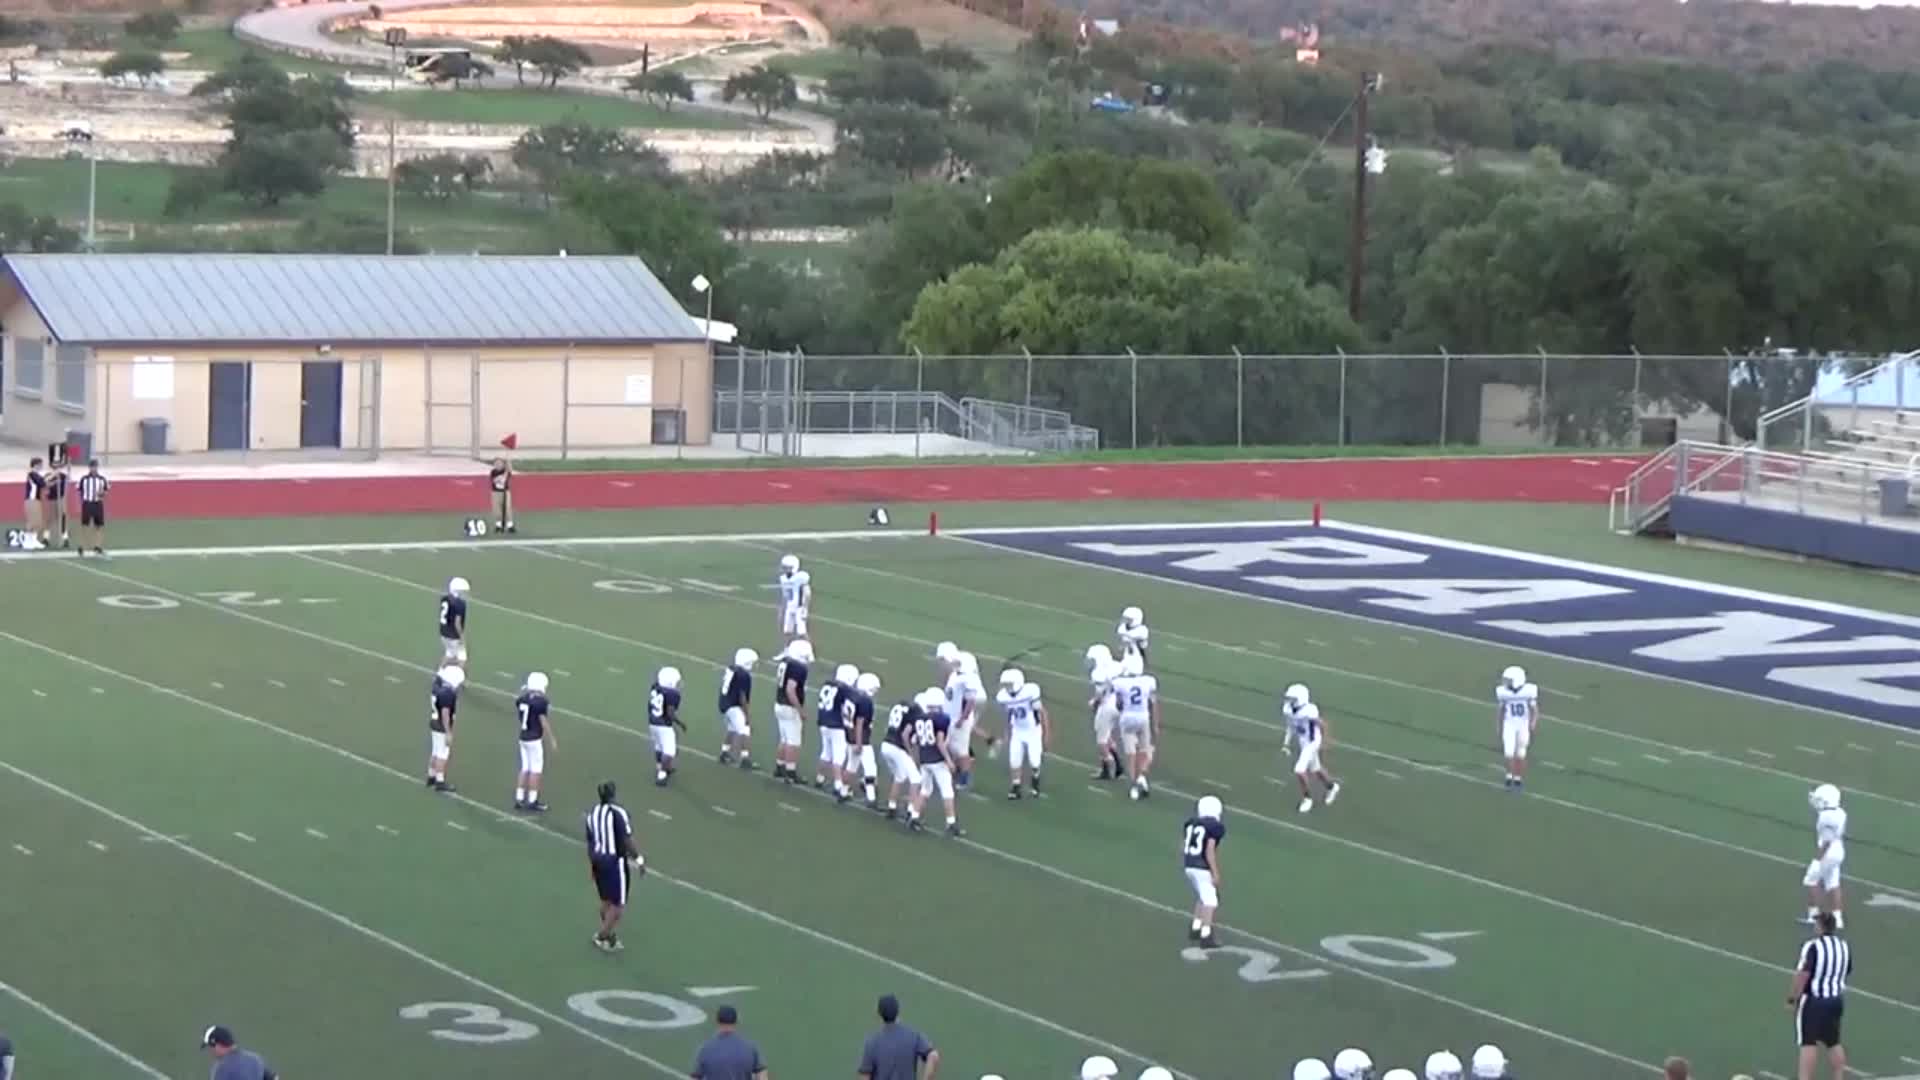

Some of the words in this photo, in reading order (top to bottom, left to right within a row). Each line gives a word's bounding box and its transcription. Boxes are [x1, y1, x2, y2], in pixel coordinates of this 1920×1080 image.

[468, 519, 487, 537] 10
[1130, 687, 1142, 705] 2
[519, 703, 529, 730] 7
[1184, 825, 1206, 856] 13
[1181, 935, 1457, 981] 20
[399, 989, 708, 1043] 30
